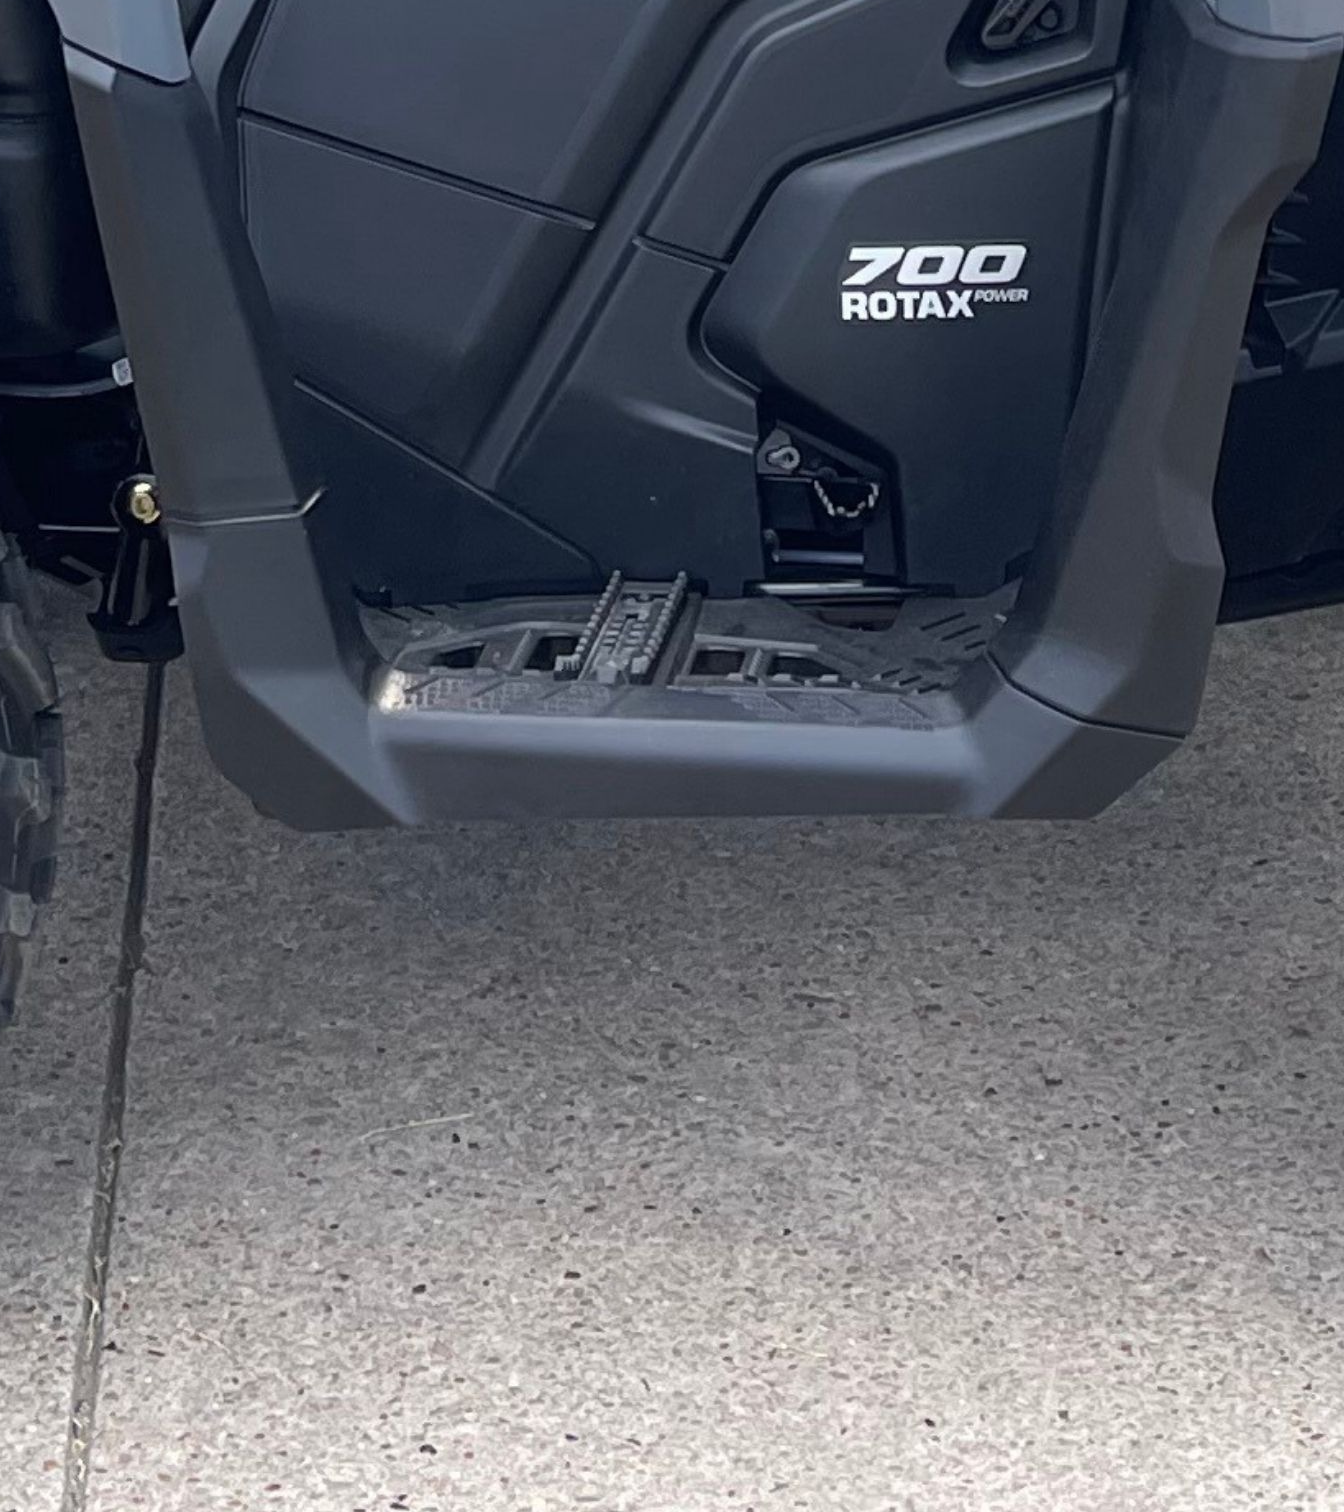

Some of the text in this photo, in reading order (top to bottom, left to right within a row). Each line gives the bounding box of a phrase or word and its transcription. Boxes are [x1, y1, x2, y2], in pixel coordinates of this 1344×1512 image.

[841, 244, 1027, 286] 700
[841, 288, 1029, 321] ROTAX POWER
